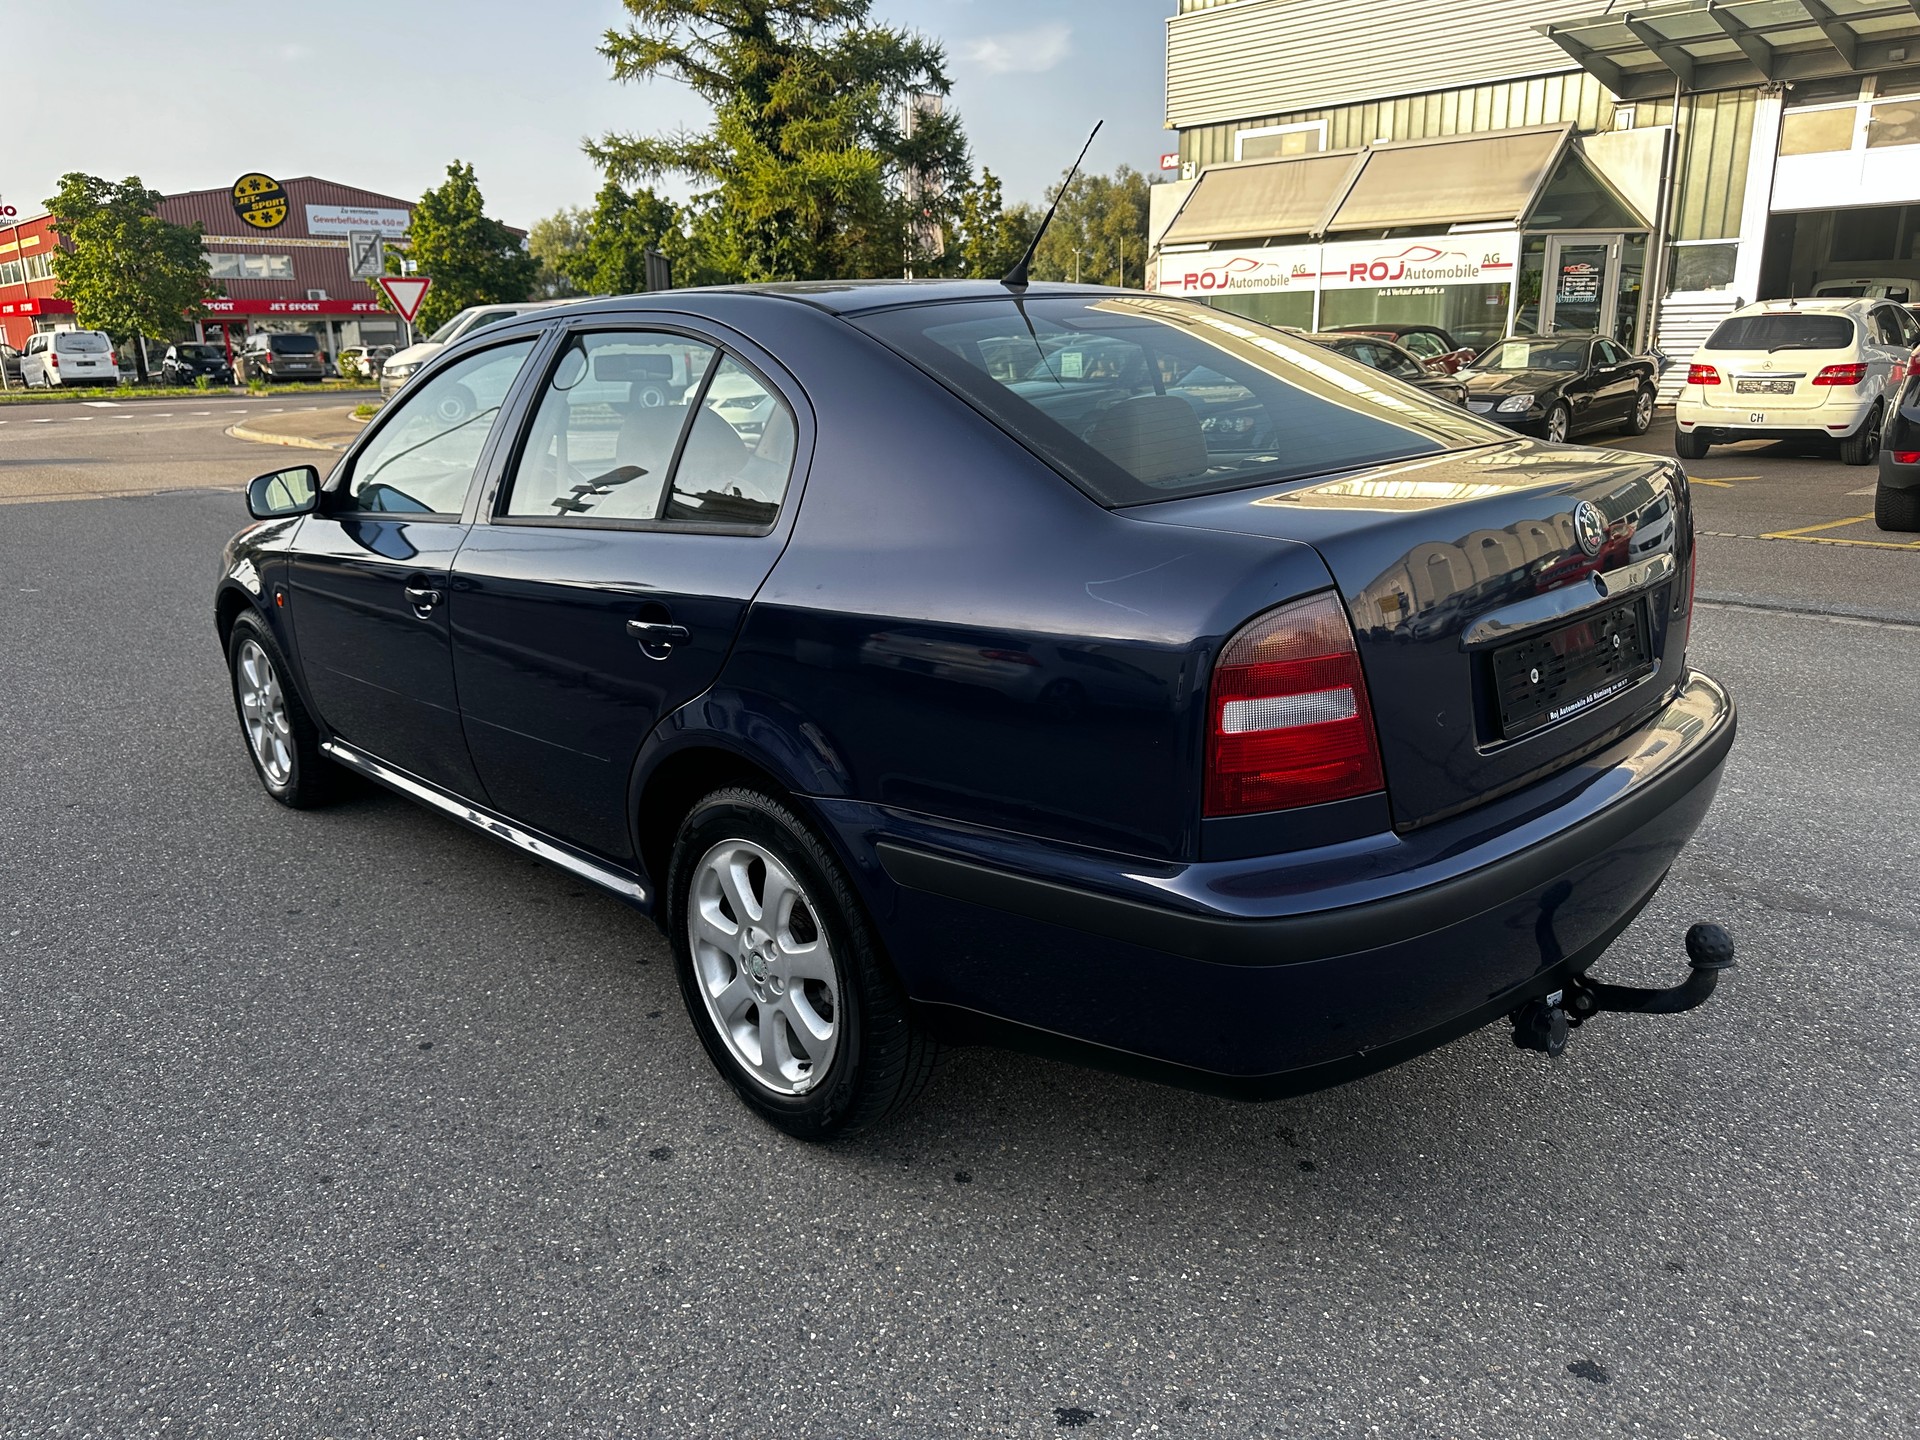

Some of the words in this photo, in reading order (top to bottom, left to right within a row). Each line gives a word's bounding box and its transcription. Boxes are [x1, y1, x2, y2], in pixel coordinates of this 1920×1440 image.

[251, 197, 285, 210] SPORT
[313, 215, 369, 225] Gewerbefläche
[382, 219, 395, 227] 450
[1349, 261, 1405, 282] ROJ
[1404, 264, 1480, 280] Automobile
[1482, 253, 1501, 264] AG
[1184, 271, 1230, 291] ROJ
[1228, 274, 1290, 289] Automobile
[1291, 264, 1306, 275] AG
[1386, 288, 1391, 296] &
[1424, 286, 1445, 295] Markn
[269, 303, 286, 311] JET
[288, 303, 320, 311] SPORT
[351, 303, 368, 311] JET
[1750, 413, 1764, 423] CH
[1550, 709, 1560, 720] Roj
[1560, 698, 1586, 716] Automobile
[1586, 694, 1594, 704] AG
